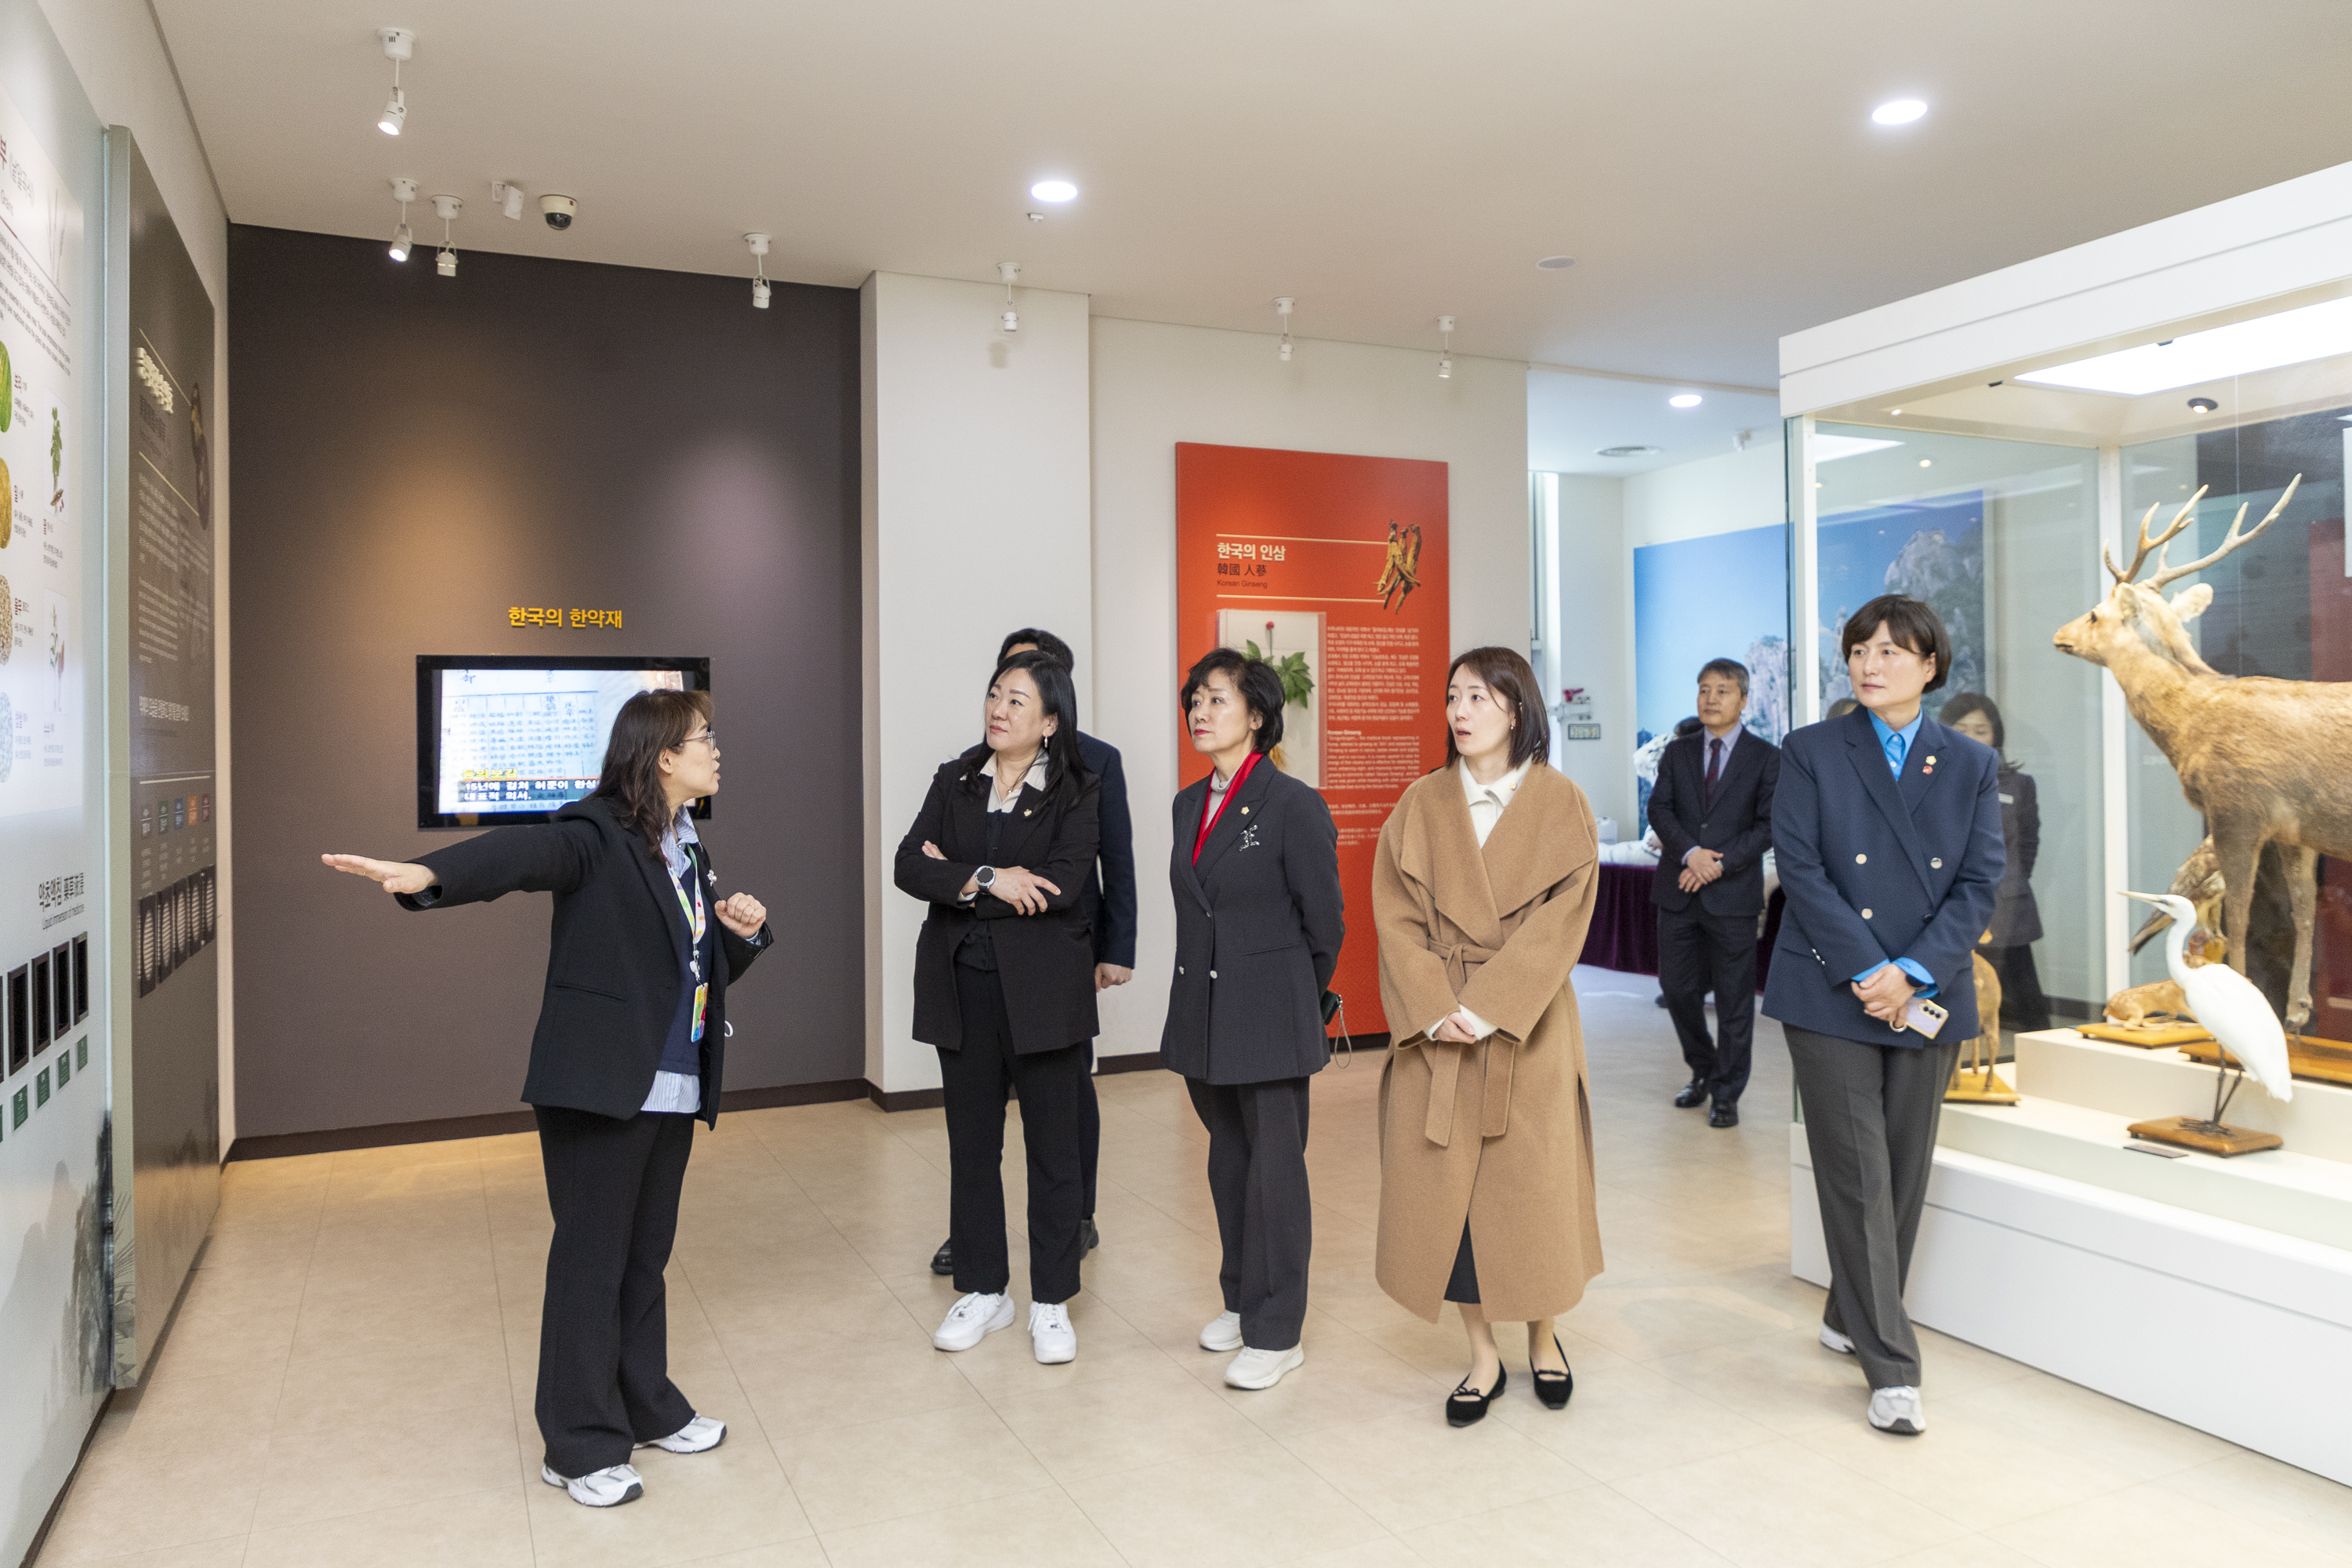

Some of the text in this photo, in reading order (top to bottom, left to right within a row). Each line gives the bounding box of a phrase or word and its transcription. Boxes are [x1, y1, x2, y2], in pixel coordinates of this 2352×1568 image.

[1218, 542, 1287, 562] 한국의 인삼
[1217, 563, 1240, 576] 韓國
[1241, 579, 1268, 589] Ginseng
[508, 606, 623, 629] 한국의 한약재
[465, 781, 501, 792] 15년에
[535, 779, 568, 790] 허준이
[463, 790, 532, 801] 대표적 의서.
